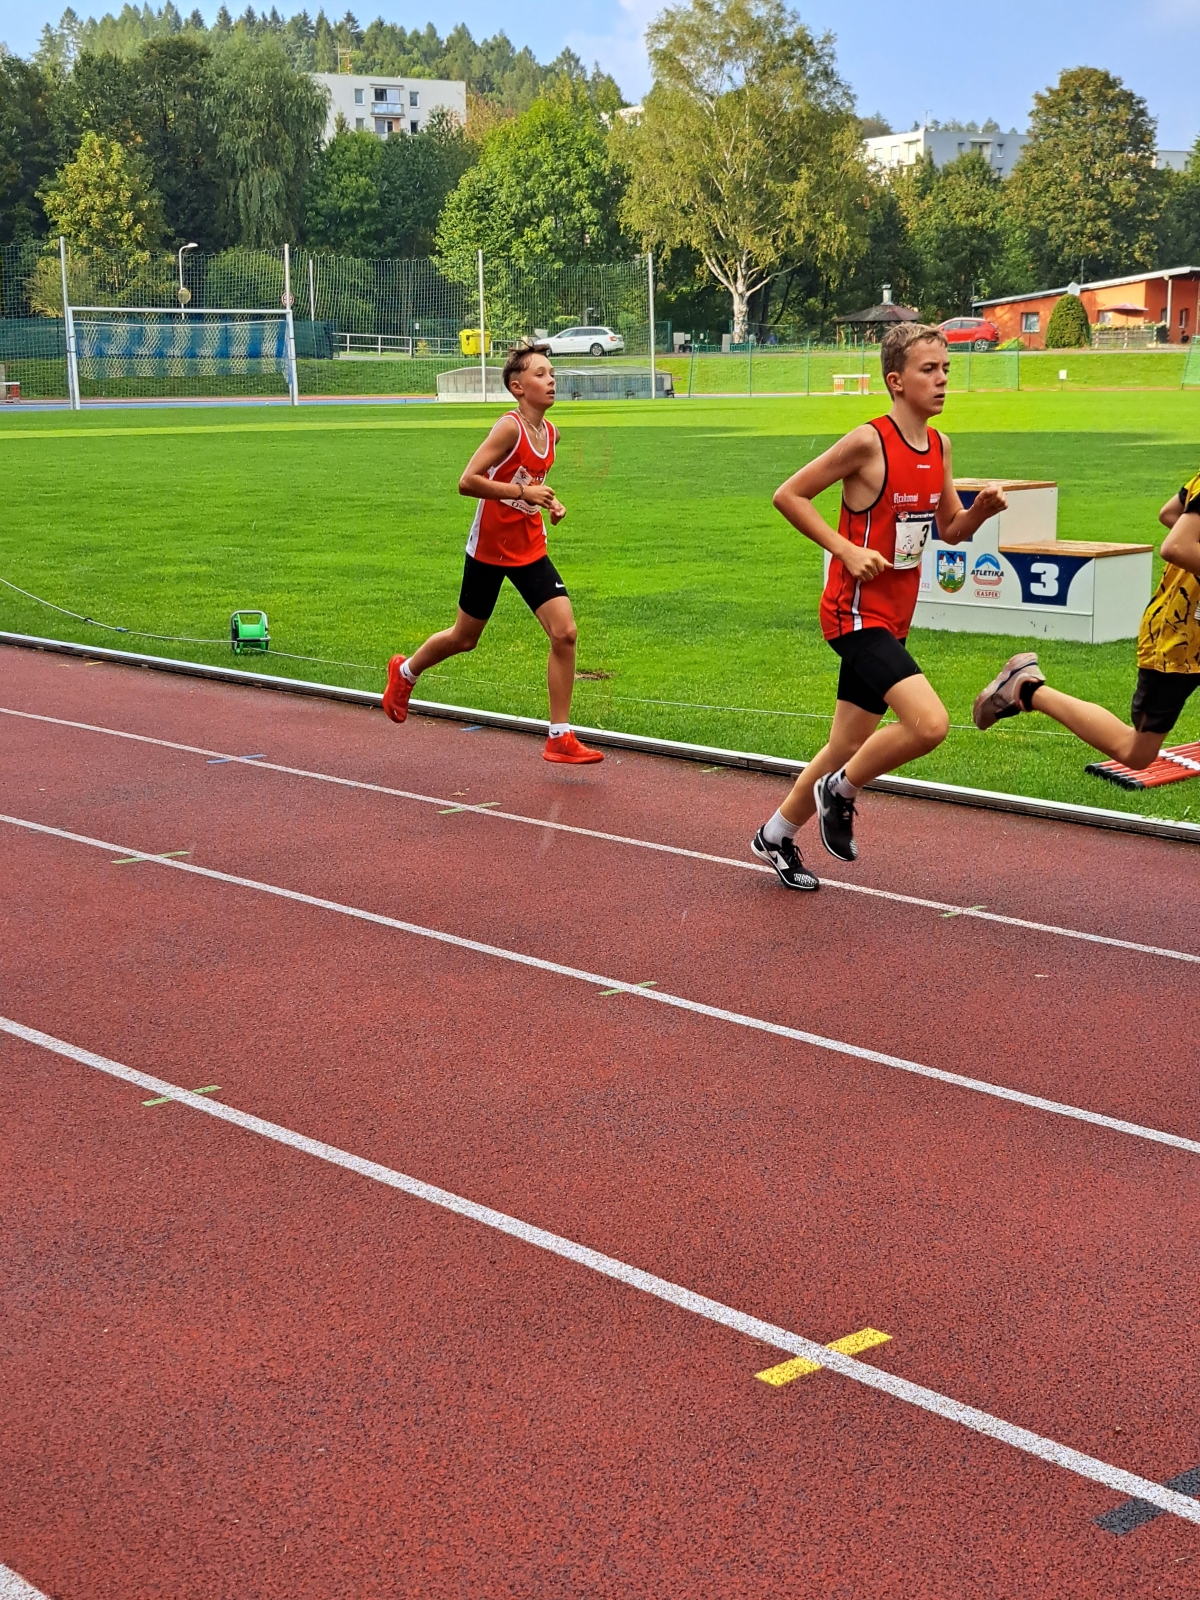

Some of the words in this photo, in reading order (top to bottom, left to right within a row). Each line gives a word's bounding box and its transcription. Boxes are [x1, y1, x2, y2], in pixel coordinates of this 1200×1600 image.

[970, 569, 1005, 577] ATLETIKA
[1030, 562, 1059, 597] 3
[976, 590, 999, 598] KASPER
